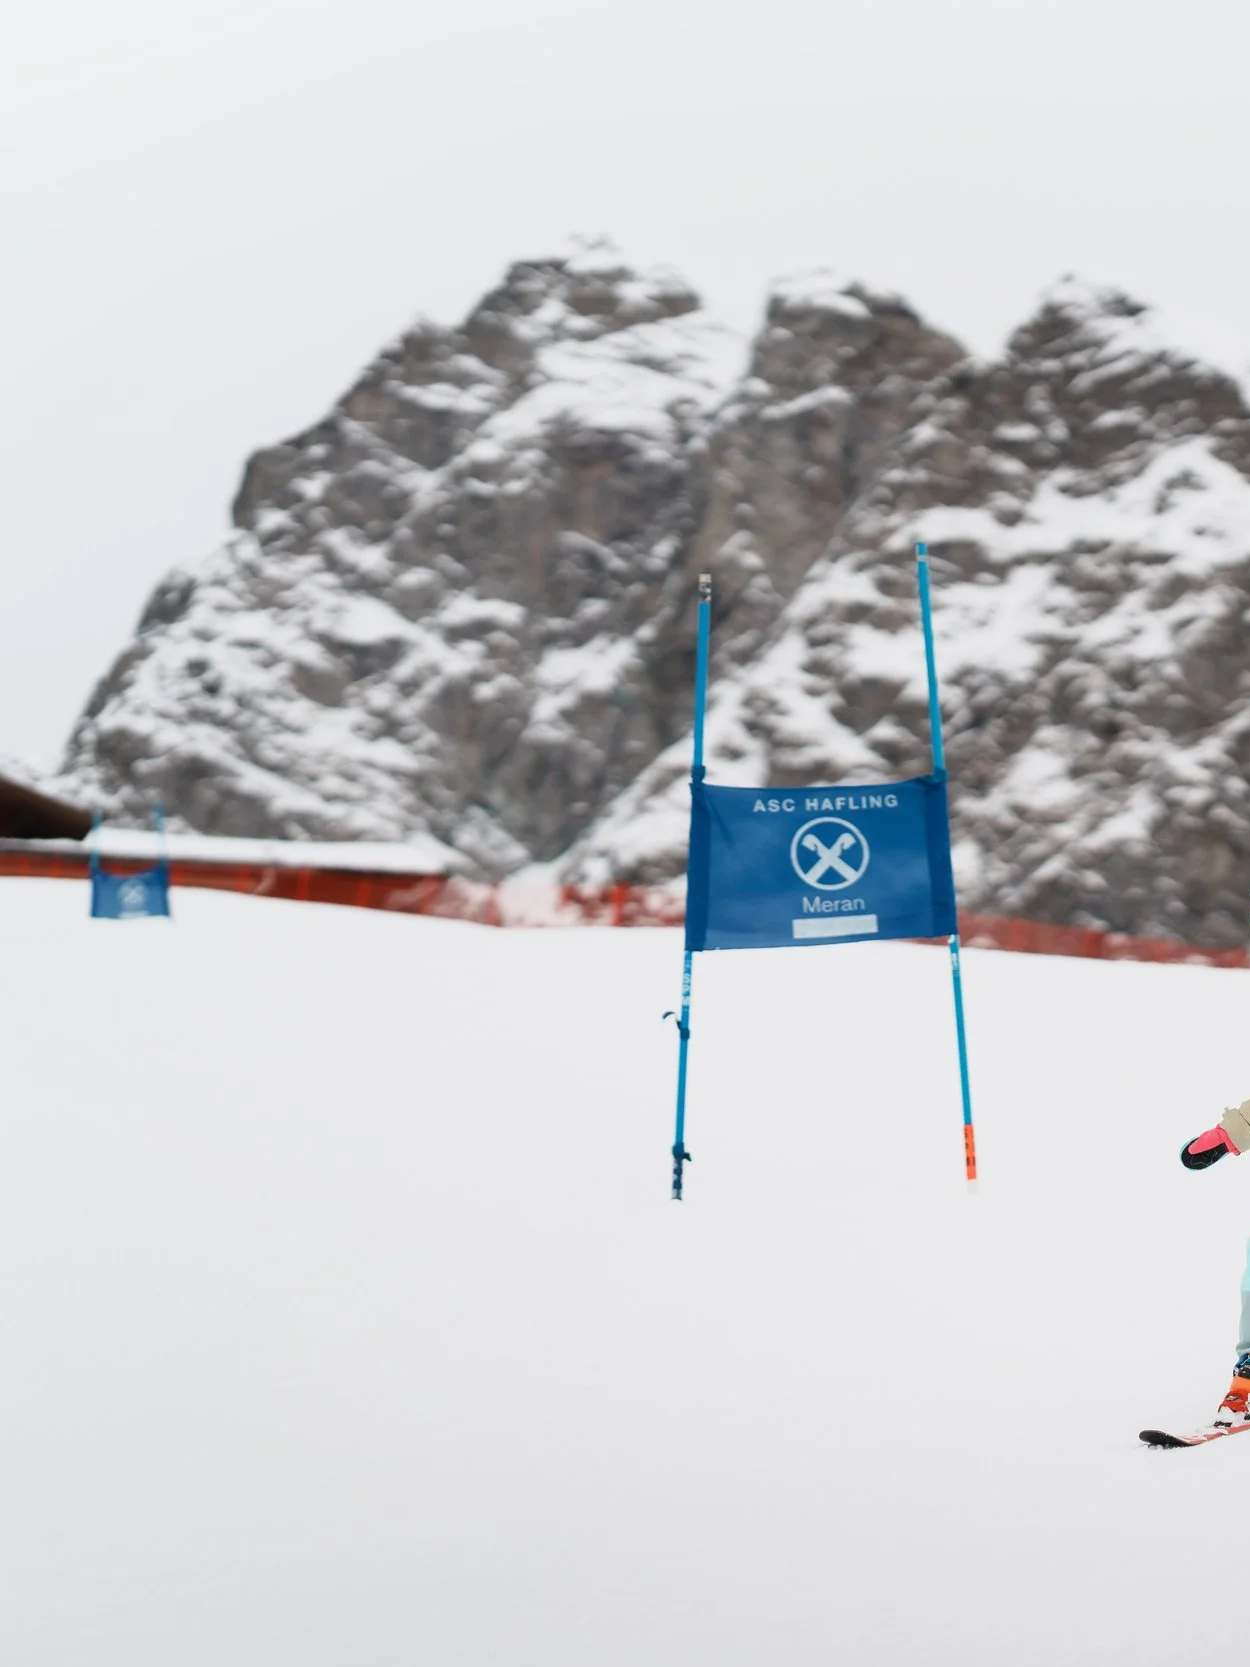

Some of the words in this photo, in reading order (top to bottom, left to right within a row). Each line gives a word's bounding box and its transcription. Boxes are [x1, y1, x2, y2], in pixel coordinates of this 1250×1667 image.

[753, 799, 795, 813] ASC
[805, 794, 899, 812] HAFLING
[802, 896, 866, 913] Meran
